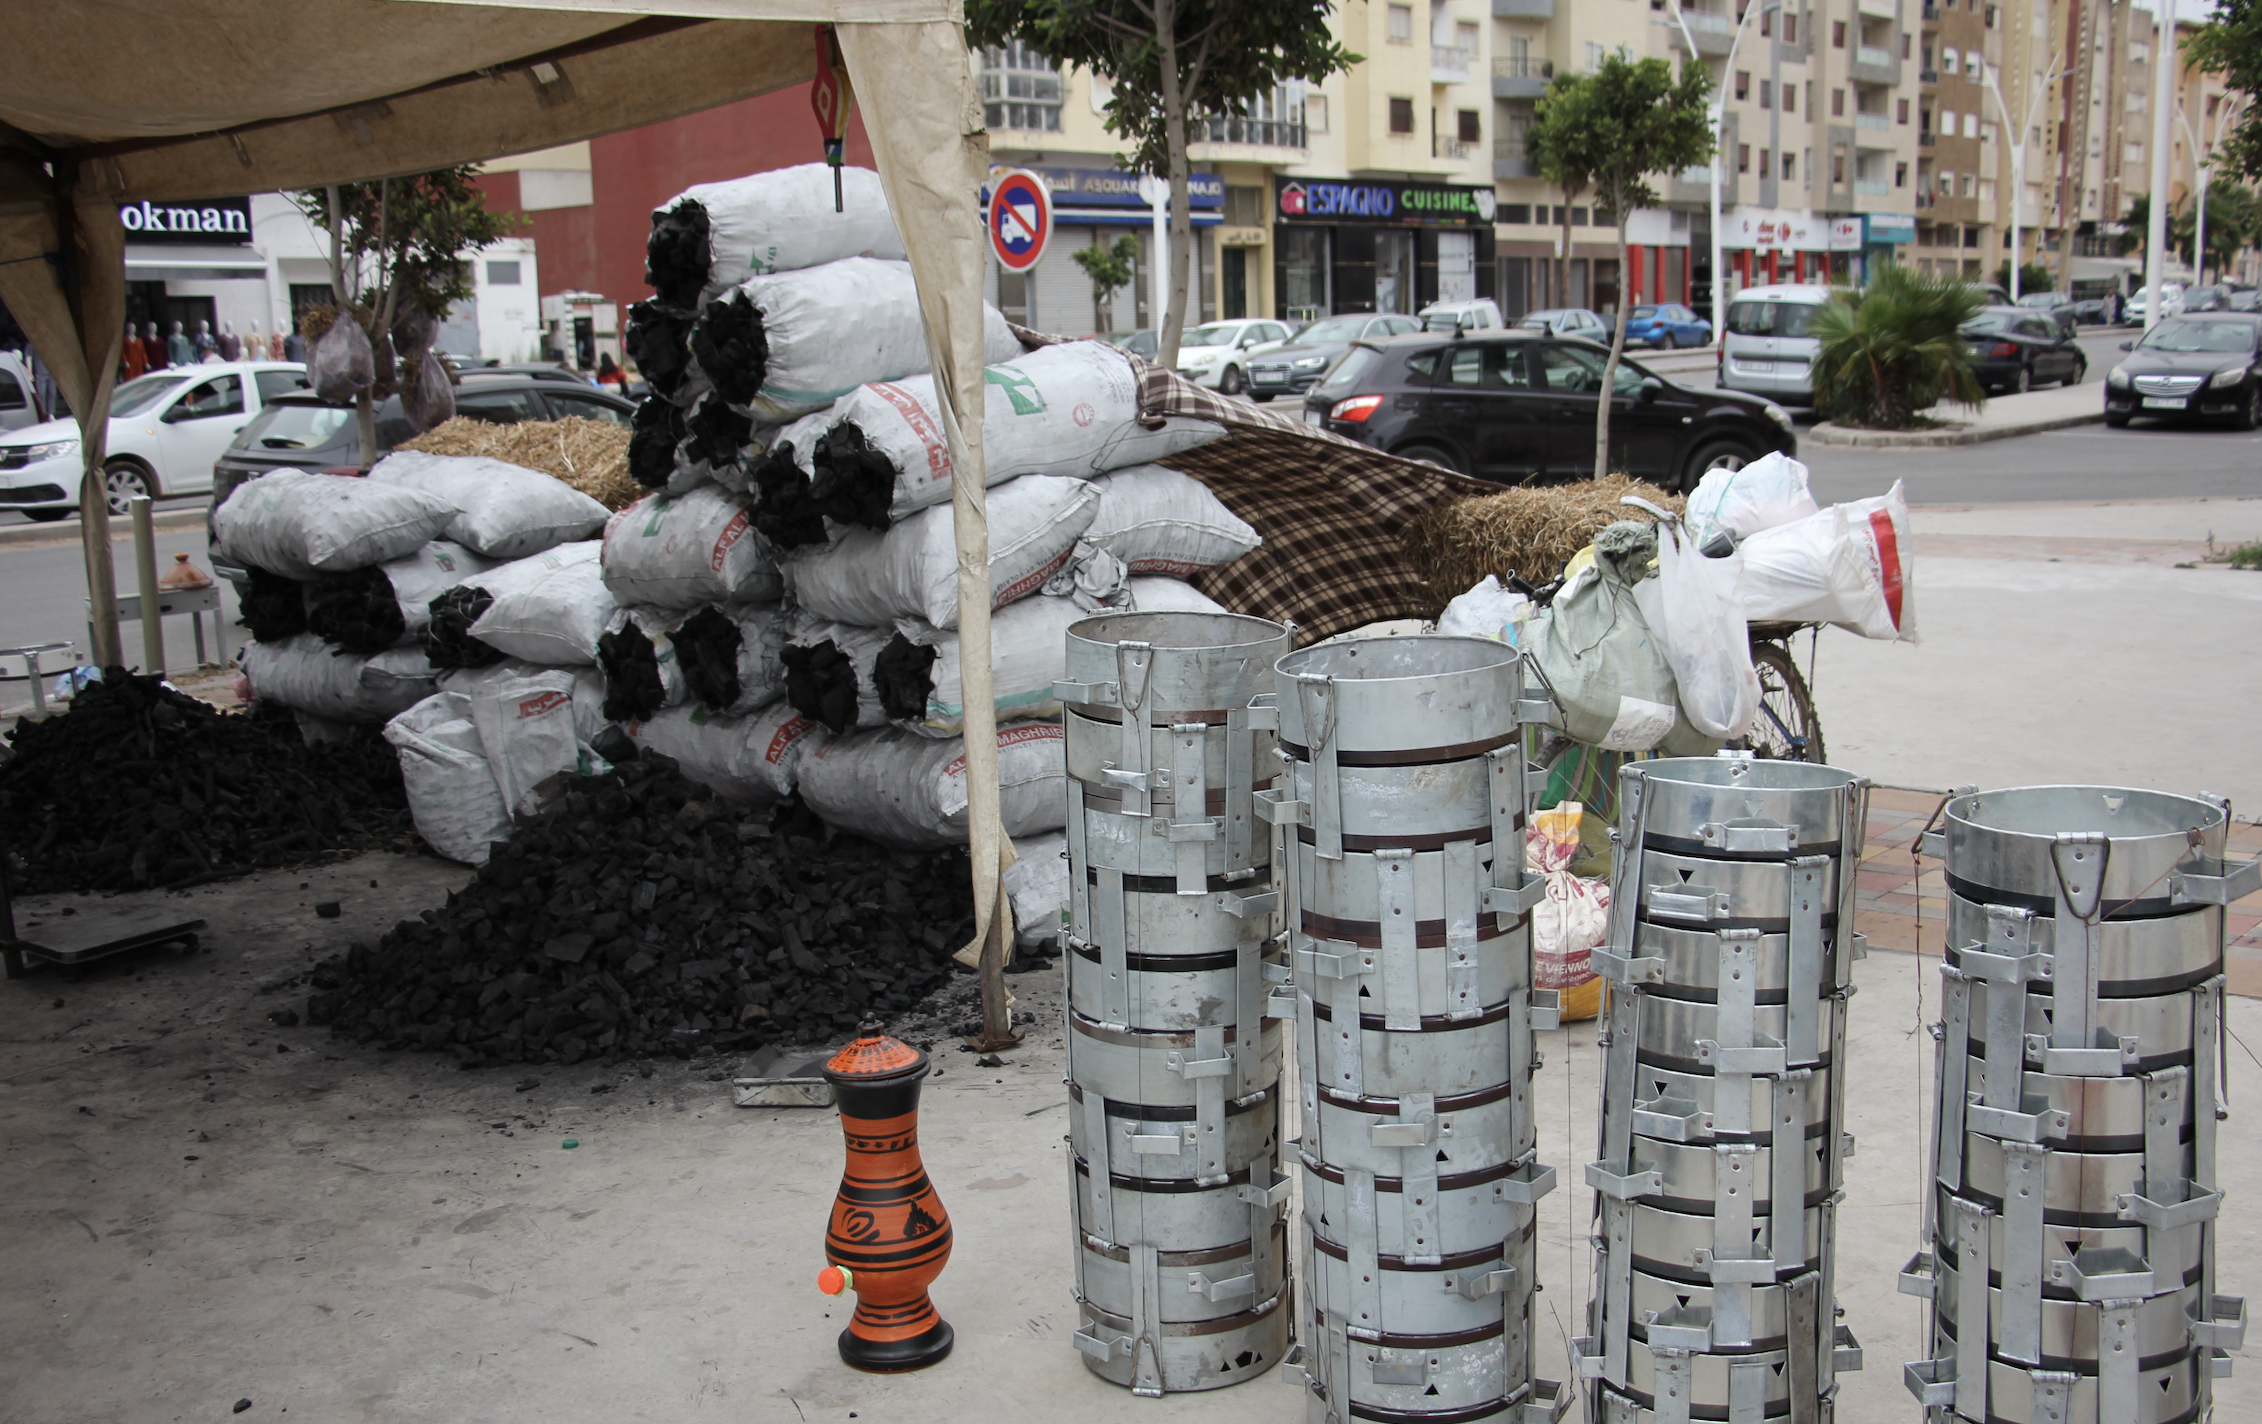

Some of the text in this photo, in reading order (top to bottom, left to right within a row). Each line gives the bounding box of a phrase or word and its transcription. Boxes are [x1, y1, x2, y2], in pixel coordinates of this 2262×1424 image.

[120, 200, 249, 232] okman
[1306, 184, 1395, 216] ESPAGNO
[1401, 189, 1479, 214] CUISINE
[714, 538, 727, 570] ALF
[726, 524, 745, 541] AL
[769, 731, 787, 761] ALF
[948, 728, 1064, 773] AL MAGHRIB
